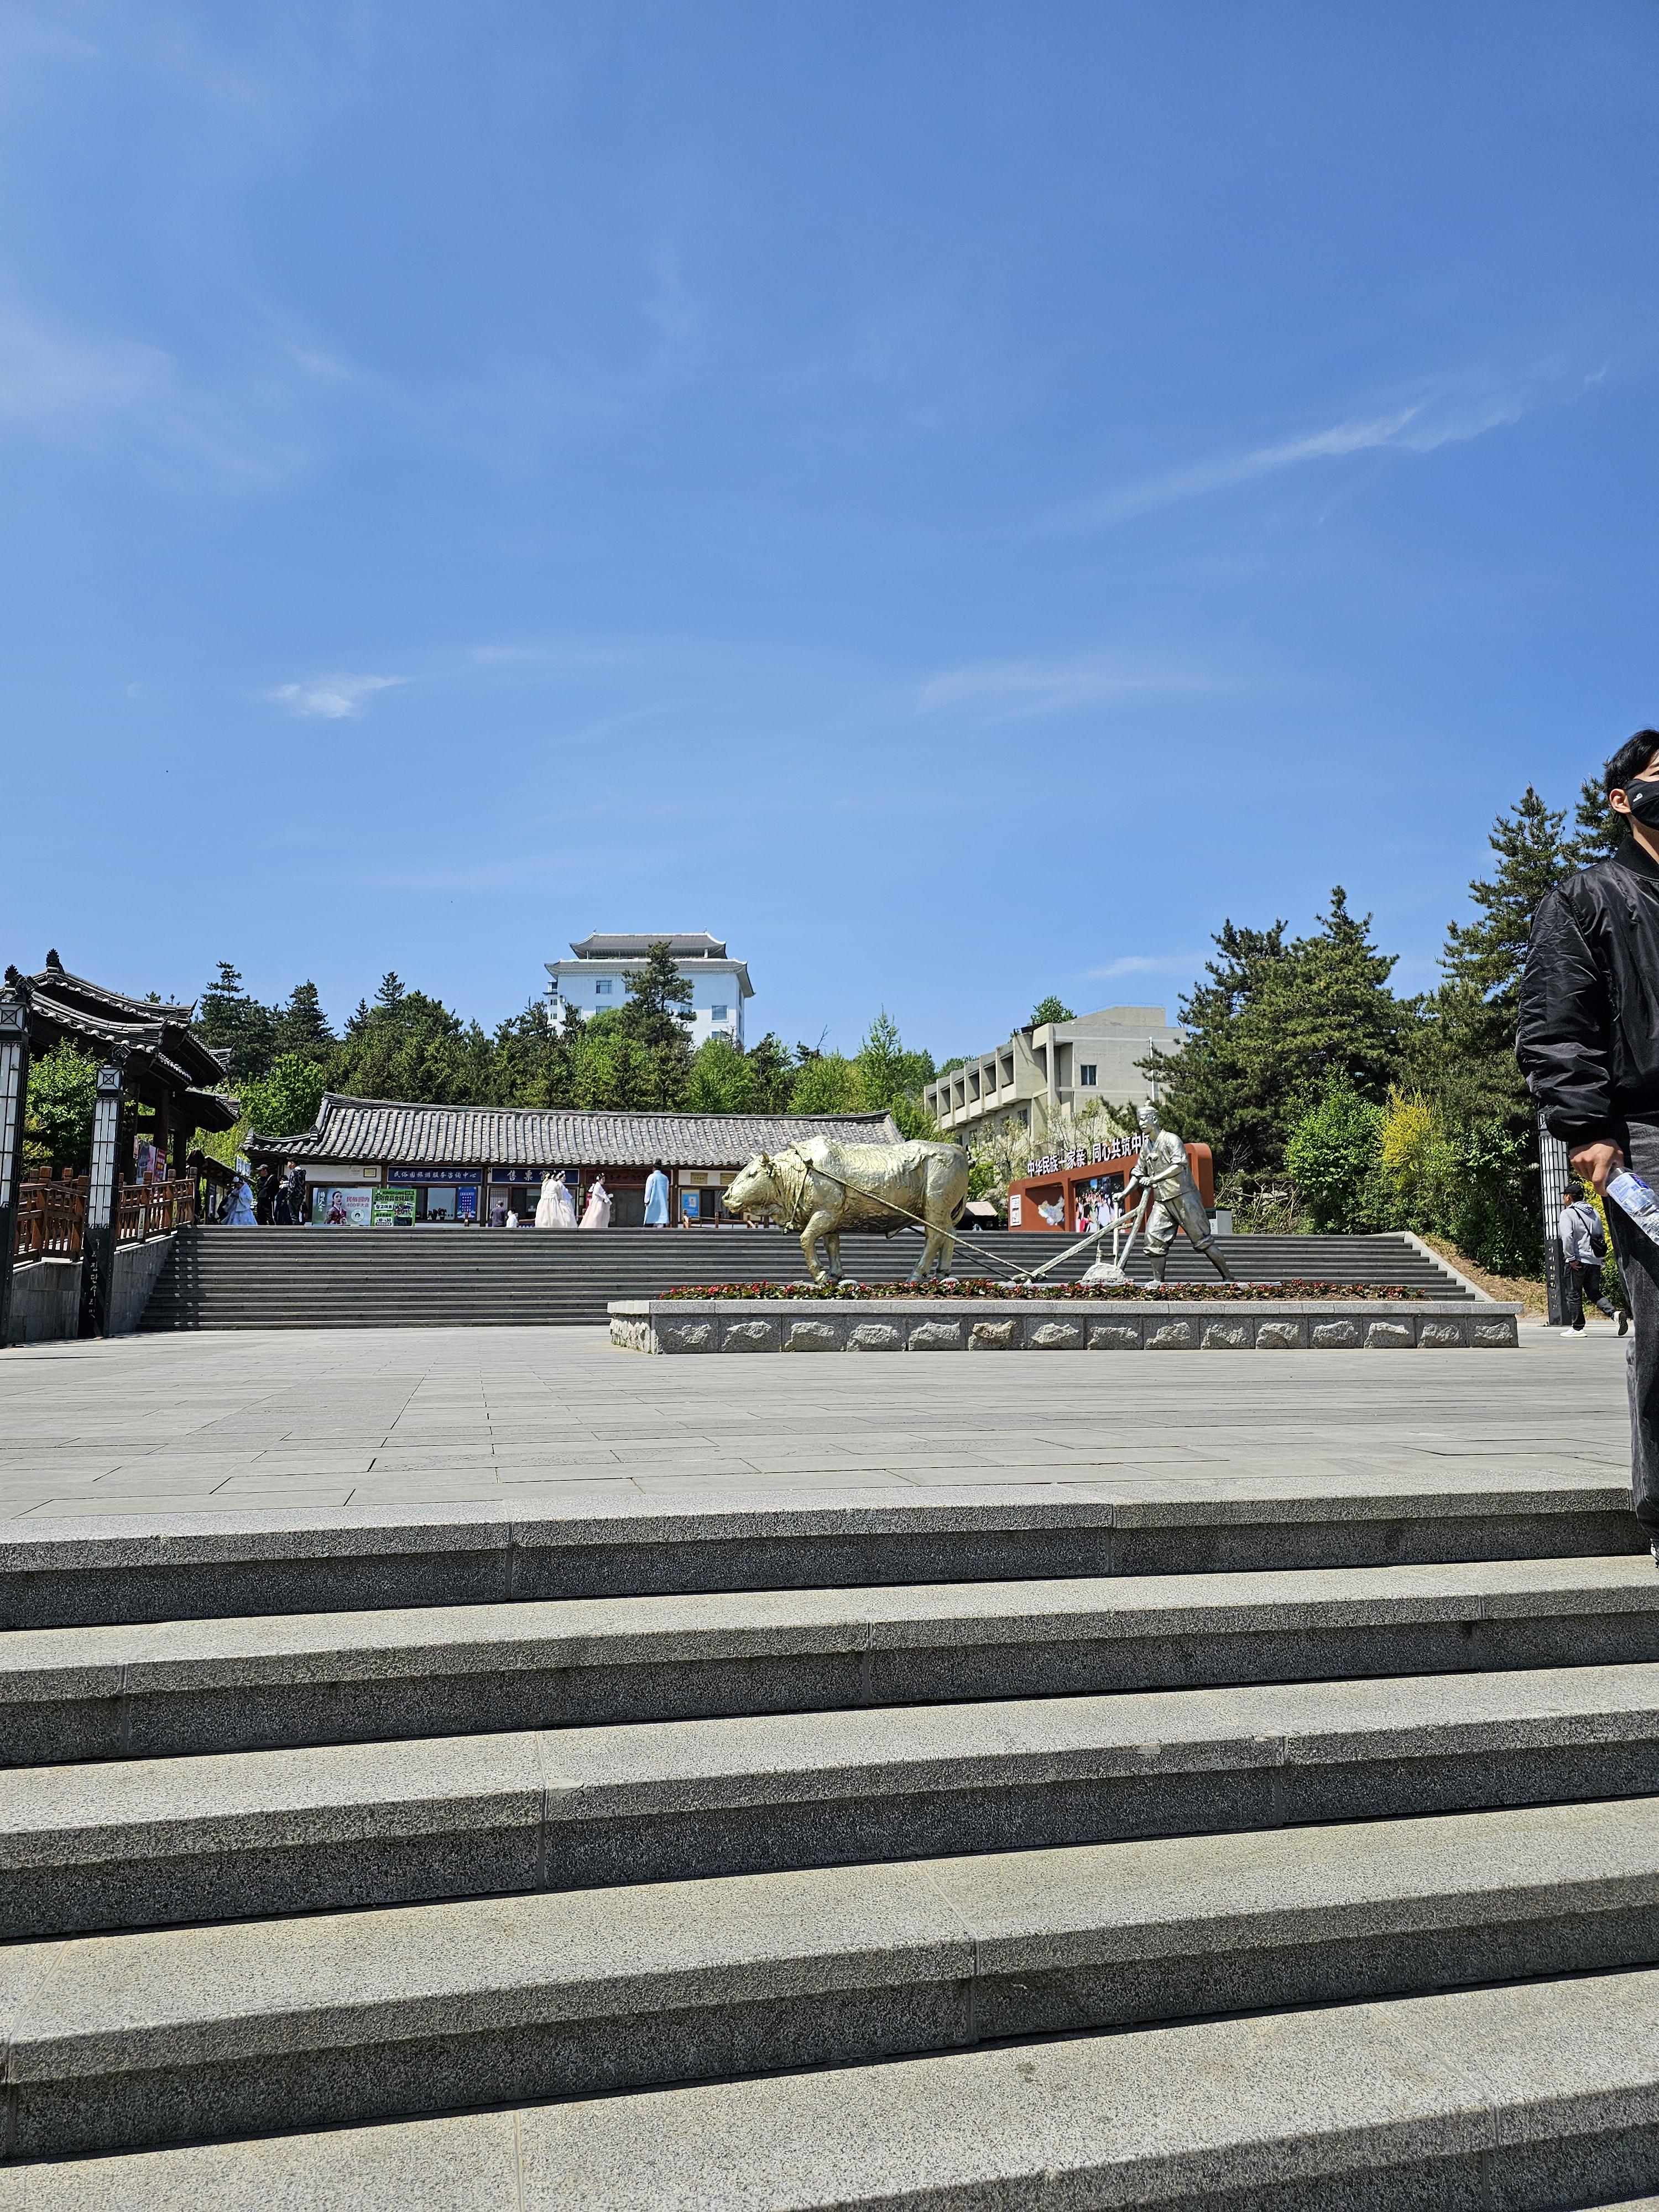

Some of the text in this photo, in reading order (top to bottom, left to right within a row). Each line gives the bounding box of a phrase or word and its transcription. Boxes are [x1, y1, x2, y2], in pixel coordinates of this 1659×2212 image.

[1027, 1147, 1087, 1177] 中华民族一家亲
